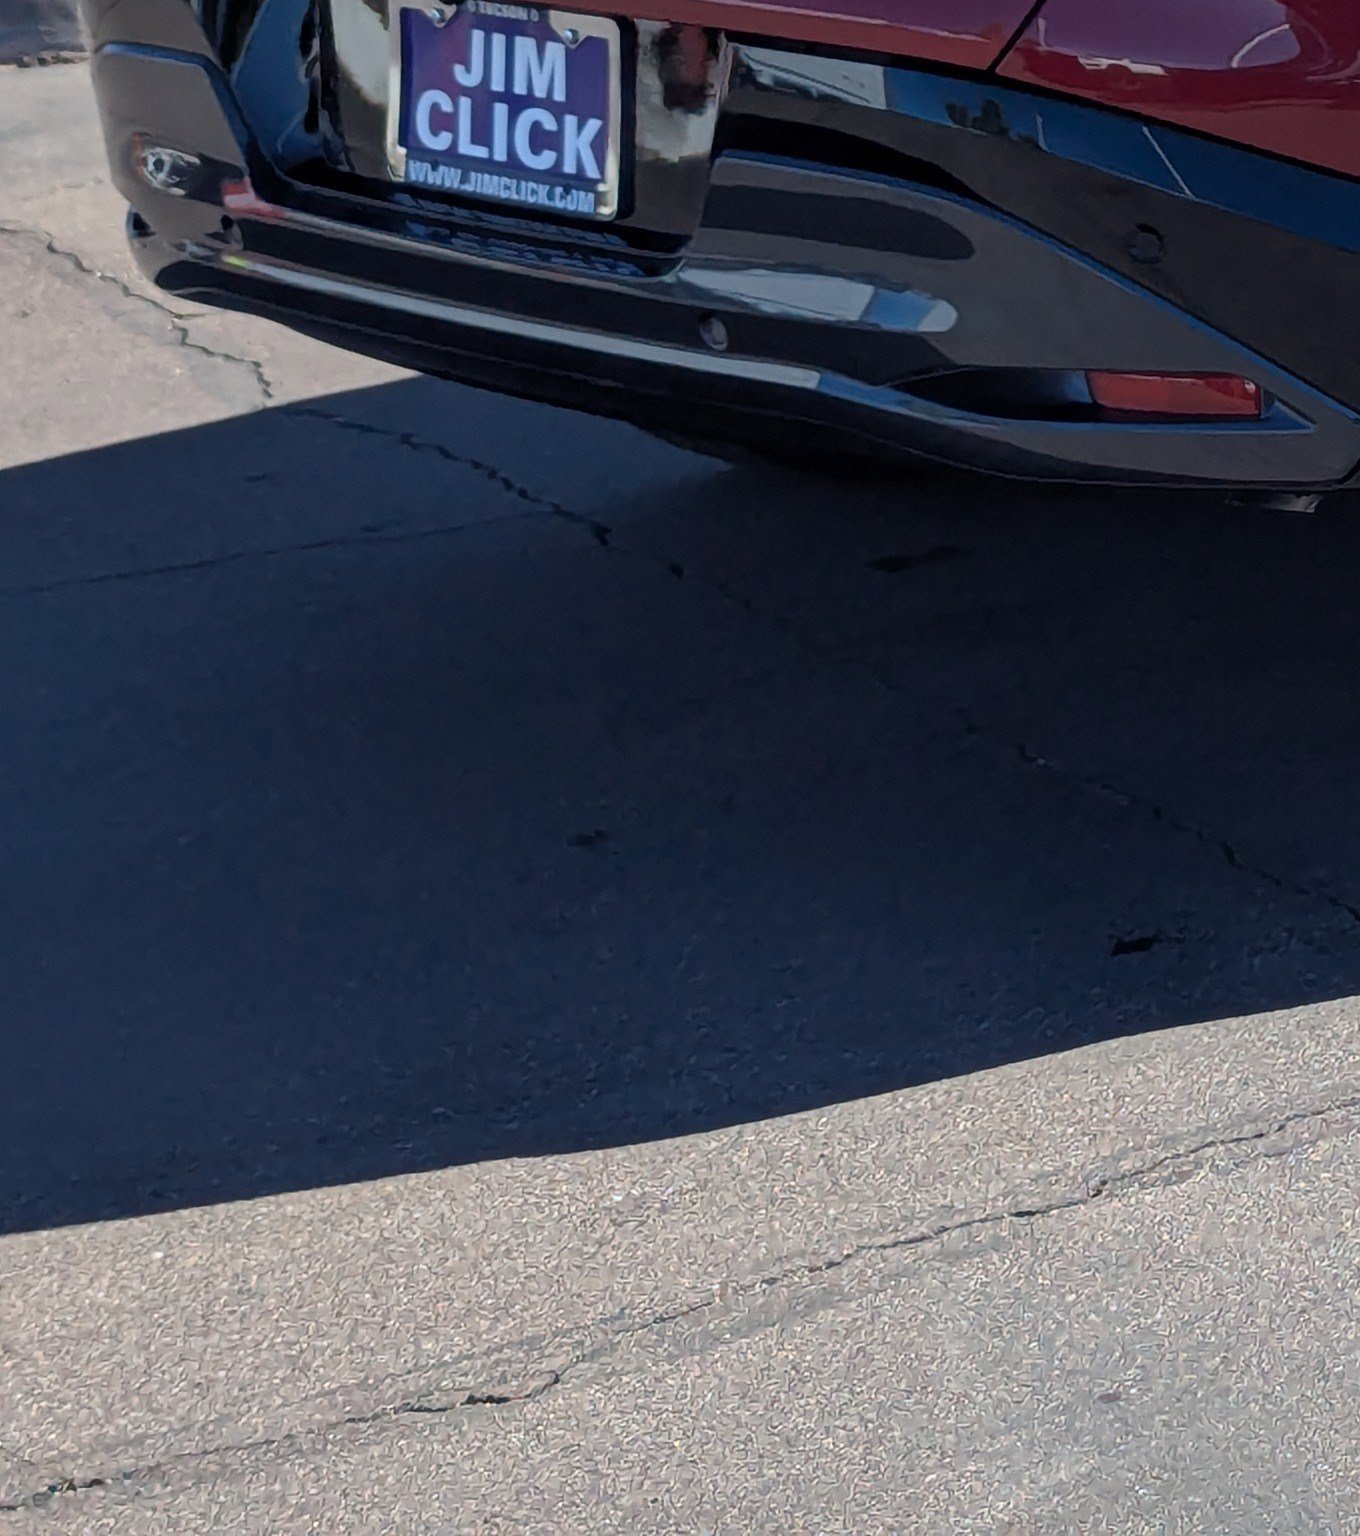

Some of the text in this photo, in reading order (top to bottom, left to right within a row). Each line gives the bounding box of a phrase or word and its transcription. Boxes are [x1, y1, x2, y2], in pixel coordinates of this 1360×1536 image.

[454, 29, 567, 103] JIM
[415, 89, 603, 179] CLICK
[407, 160, 596, 214] WWW.JIMCLICK.COM
